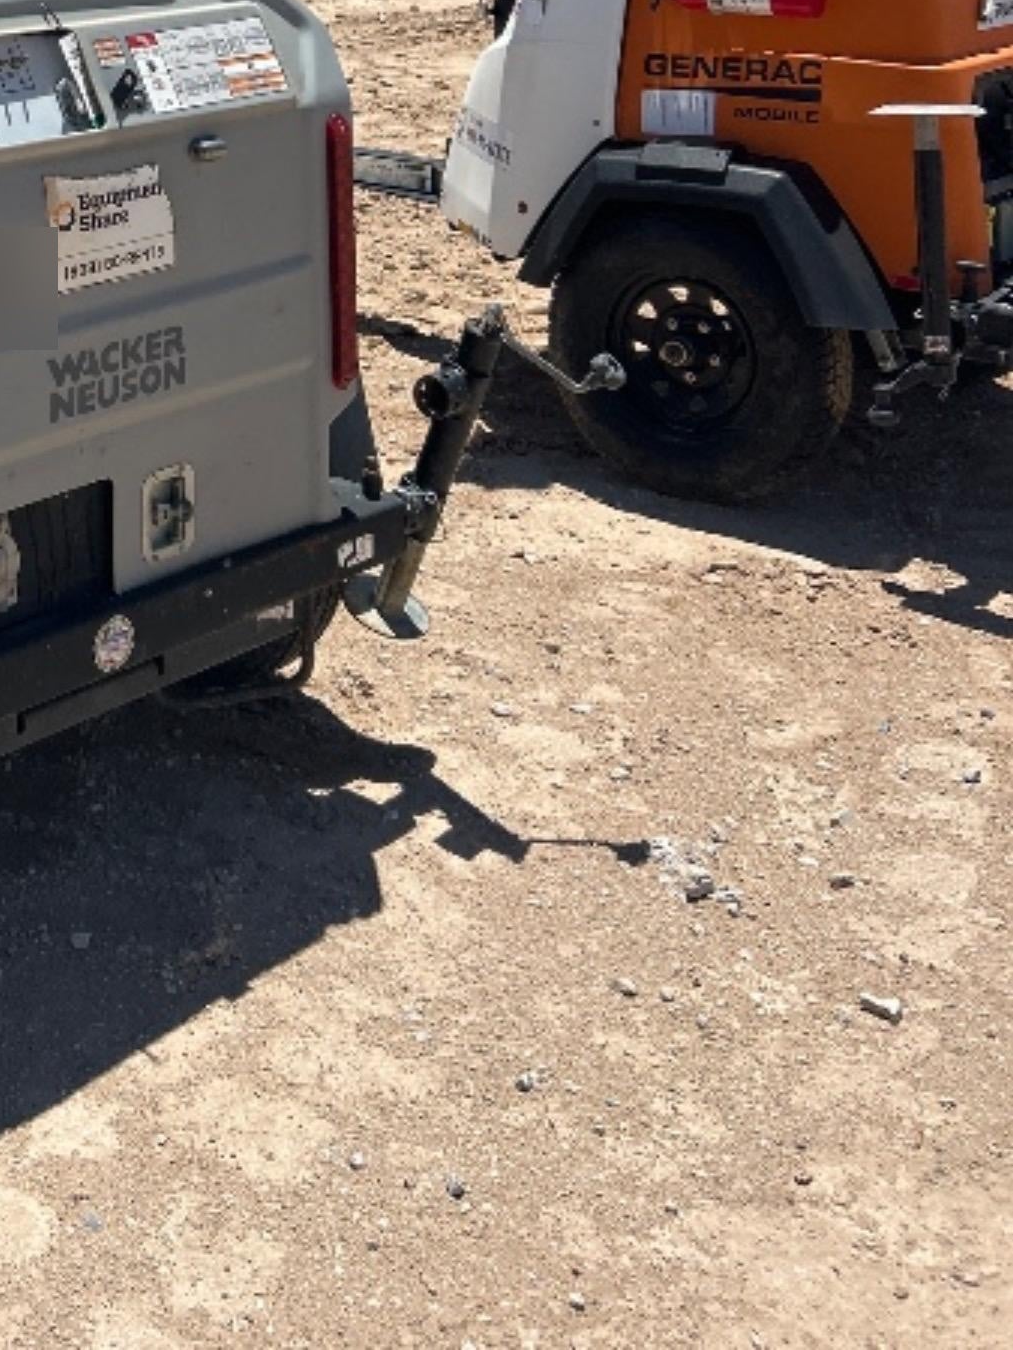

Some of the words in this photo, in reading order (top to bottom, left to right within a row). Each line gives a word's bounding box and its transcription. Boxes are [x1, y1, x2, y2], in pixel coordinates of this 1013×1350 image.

[643, 53, 823, 85] GENERAC
[732, 106, 820, 124] MOBILE
[46, 326, 187, 388] WACKER
[48, 356, 187, 423] NEUSON
